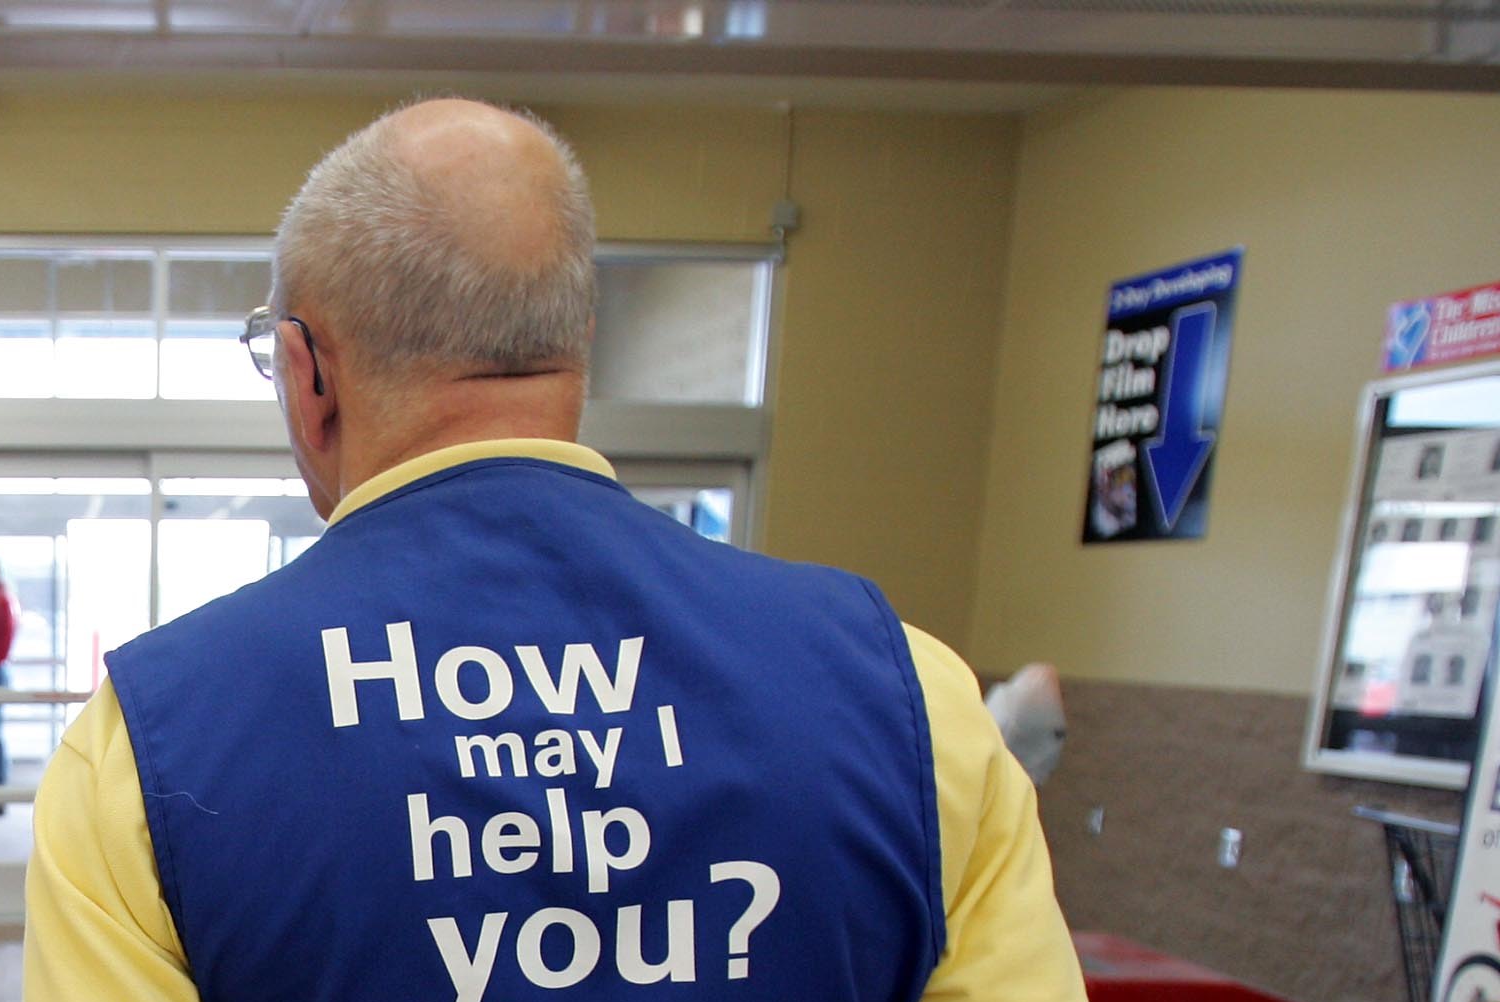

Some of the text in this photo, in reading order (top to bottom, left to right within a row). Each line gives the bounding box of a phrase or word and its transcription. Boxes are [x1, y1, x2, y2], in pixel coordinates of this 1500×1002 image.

[1106, 326, 1170, 364] Drop
[1102, 361, 1156, 400] Film
[1097, 403, 1159, 440] Here
[320, 620, 645, 728] How
[454, 705, 683, 789] may I
[407, 788, 651, 893] help
